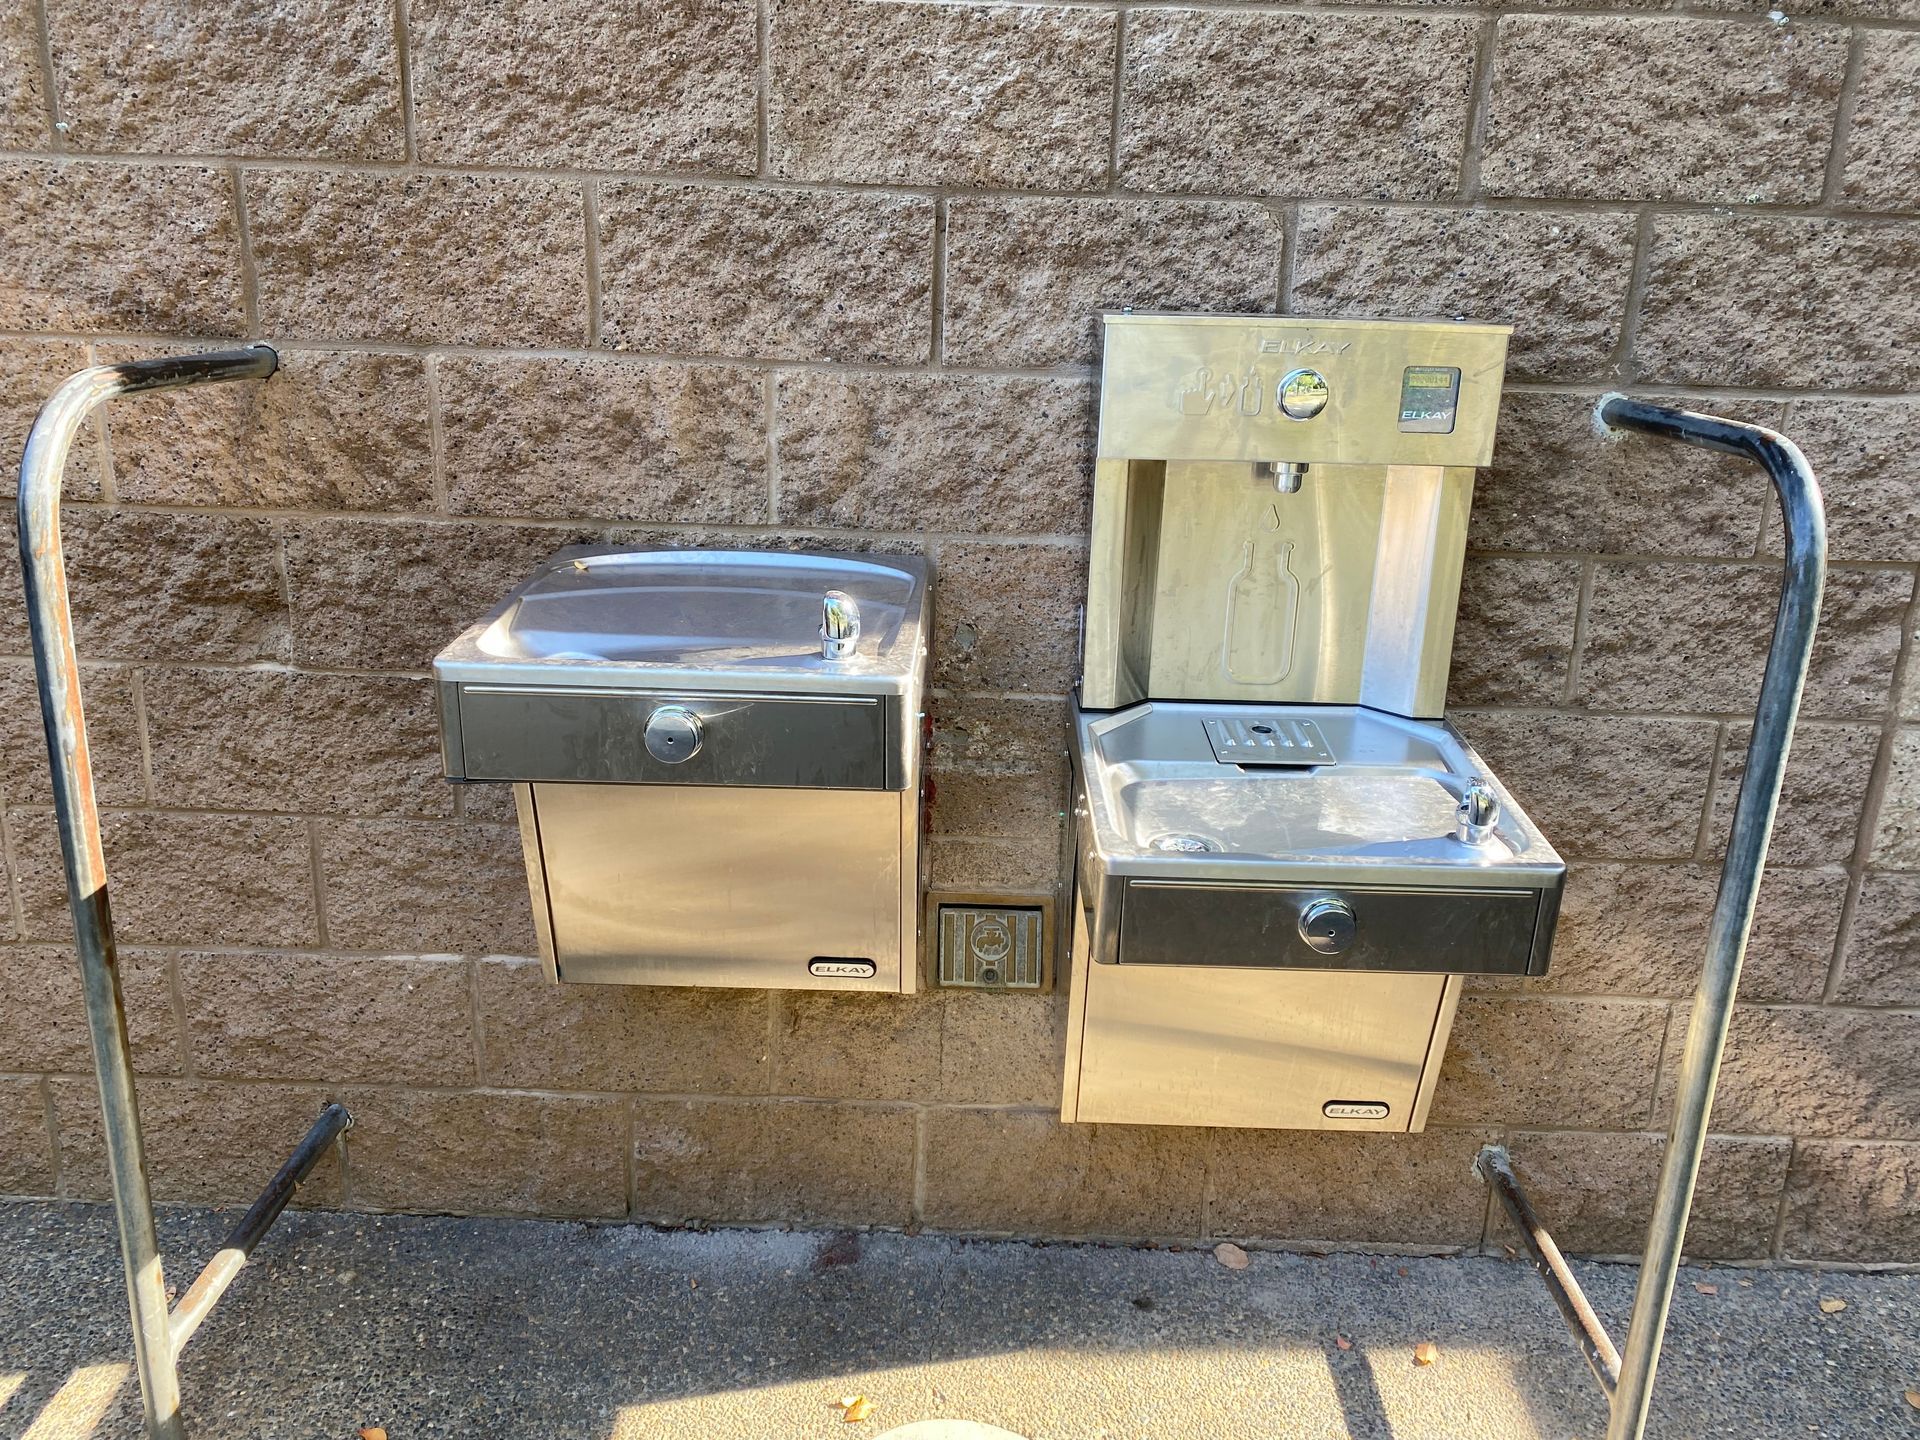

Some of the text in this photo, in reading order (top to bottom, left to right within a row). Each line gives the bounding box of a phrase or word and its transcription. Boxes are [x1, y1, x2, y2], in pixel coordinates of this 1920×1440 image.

[1260, 340, 1352, 354] ELKAY
[1402, 410, 1452, 420] ELKAY
[815, 966, 870, 974] ELKAY
